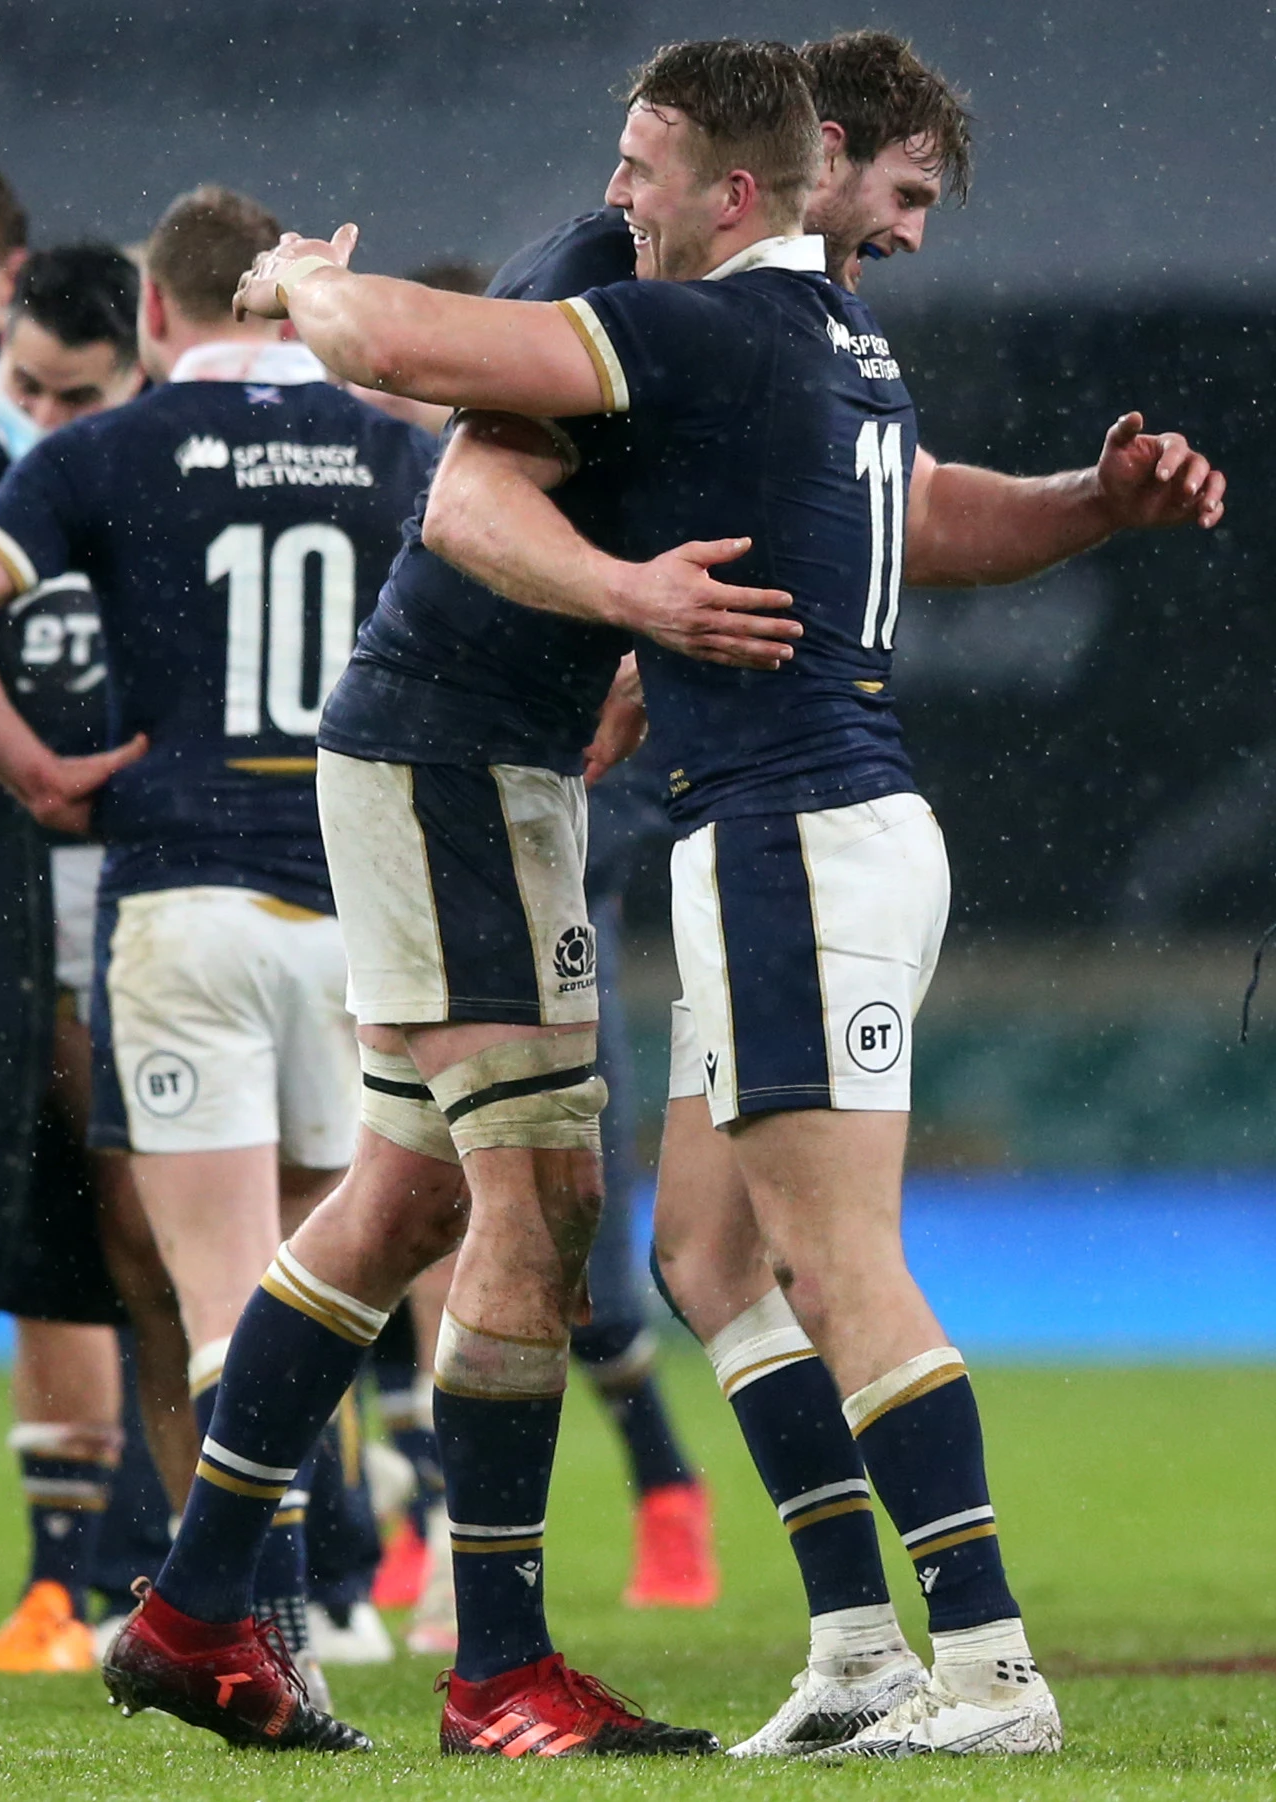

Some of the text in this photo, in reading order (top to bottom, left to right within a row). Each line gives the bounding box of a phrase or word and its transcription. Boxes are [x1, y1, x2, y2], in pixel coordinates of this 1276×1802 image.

[849, 335, 871, 355] SP
[232, 442, 358, 469] SP ENERGY
[235, 464, 374, 489] NETWORKS
[855, 420, 903, 650] 11
[21, 613, 101, 665] BT
[205, 522, 356, 738] 10
[860, 1024, 892, 1051] BT
[149, 1070, 181, 1097] BT
